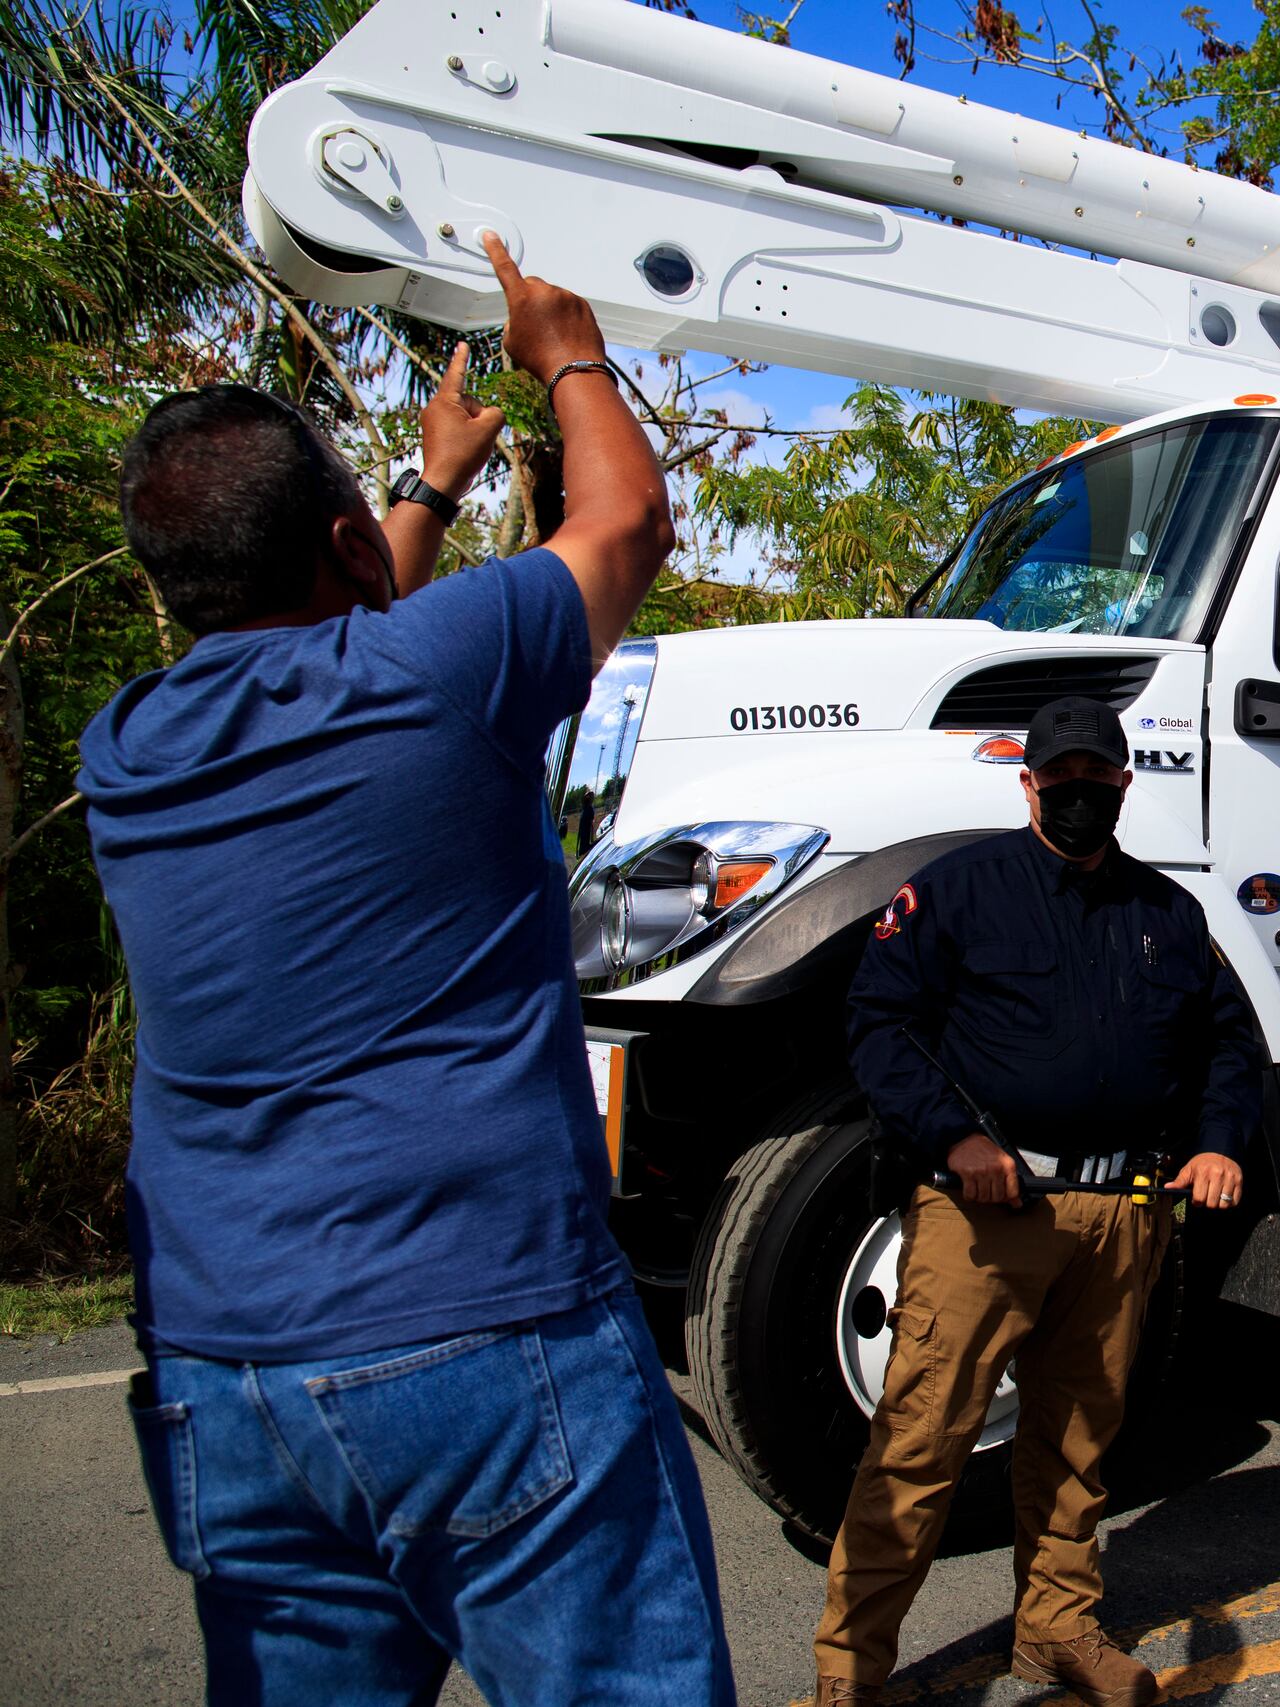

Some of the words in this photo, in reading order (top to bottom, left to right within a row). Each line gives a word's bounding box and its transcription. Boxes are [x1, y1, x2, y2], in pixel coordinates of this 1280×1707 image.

[730, 703, 860, 732] 01310036
[1160, 717, 1192, 728] Global
[1134, 750, 1195, 767] HV
